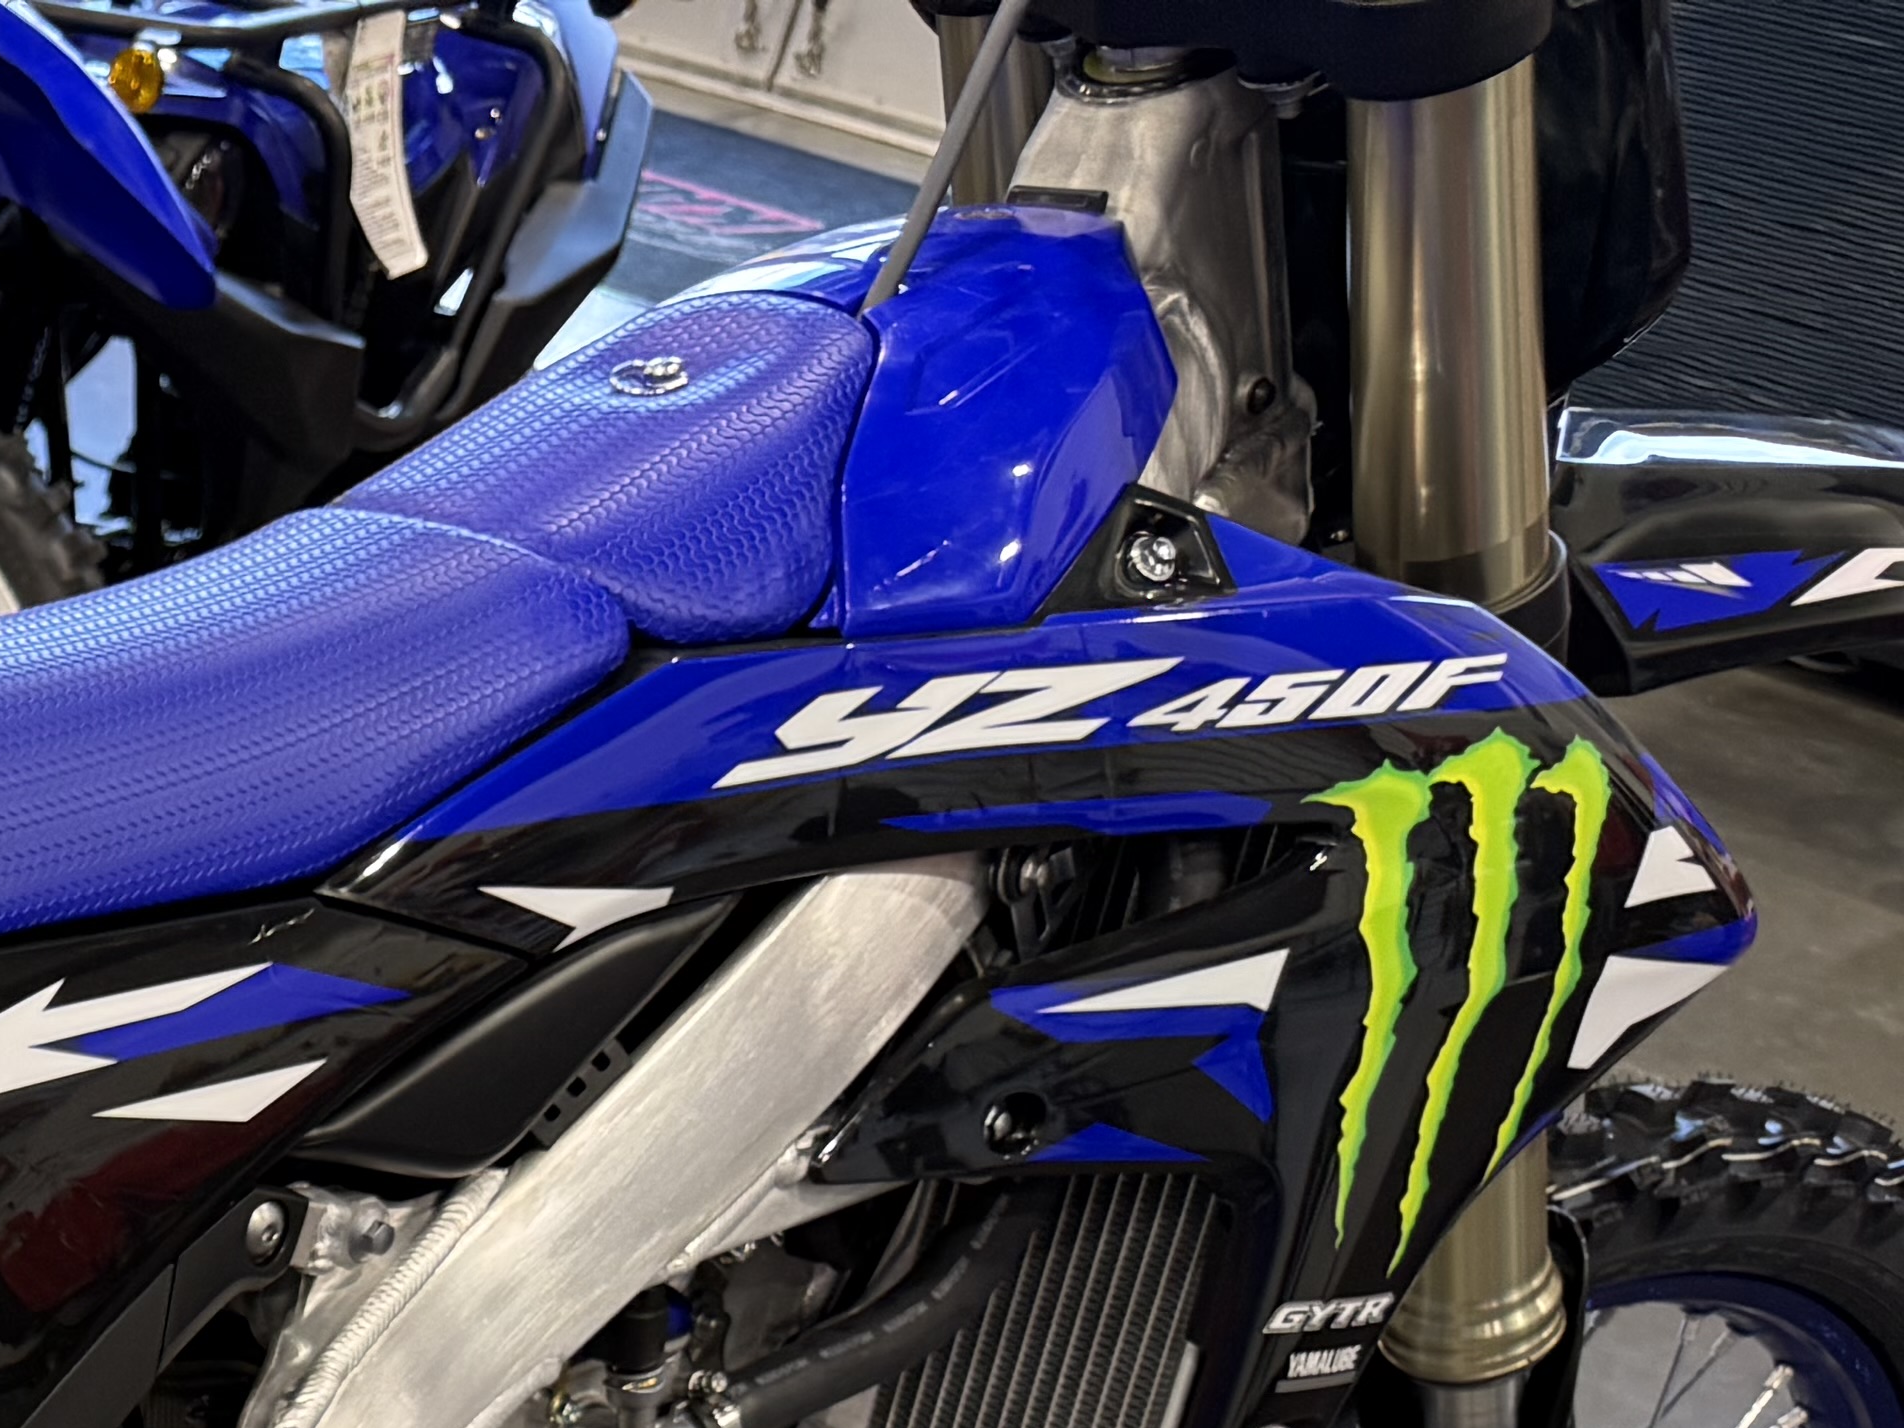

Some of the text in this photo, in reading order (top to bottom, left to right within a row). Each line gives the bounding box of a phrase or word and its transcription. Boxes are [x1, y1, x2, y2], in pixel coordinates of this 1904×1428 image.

[711, 652, 1509, 789] YZ 450F
[1262, 1292, 1395, 1335] GYTR
[1287, 1344, 1362, 1379] YAMALUBE
